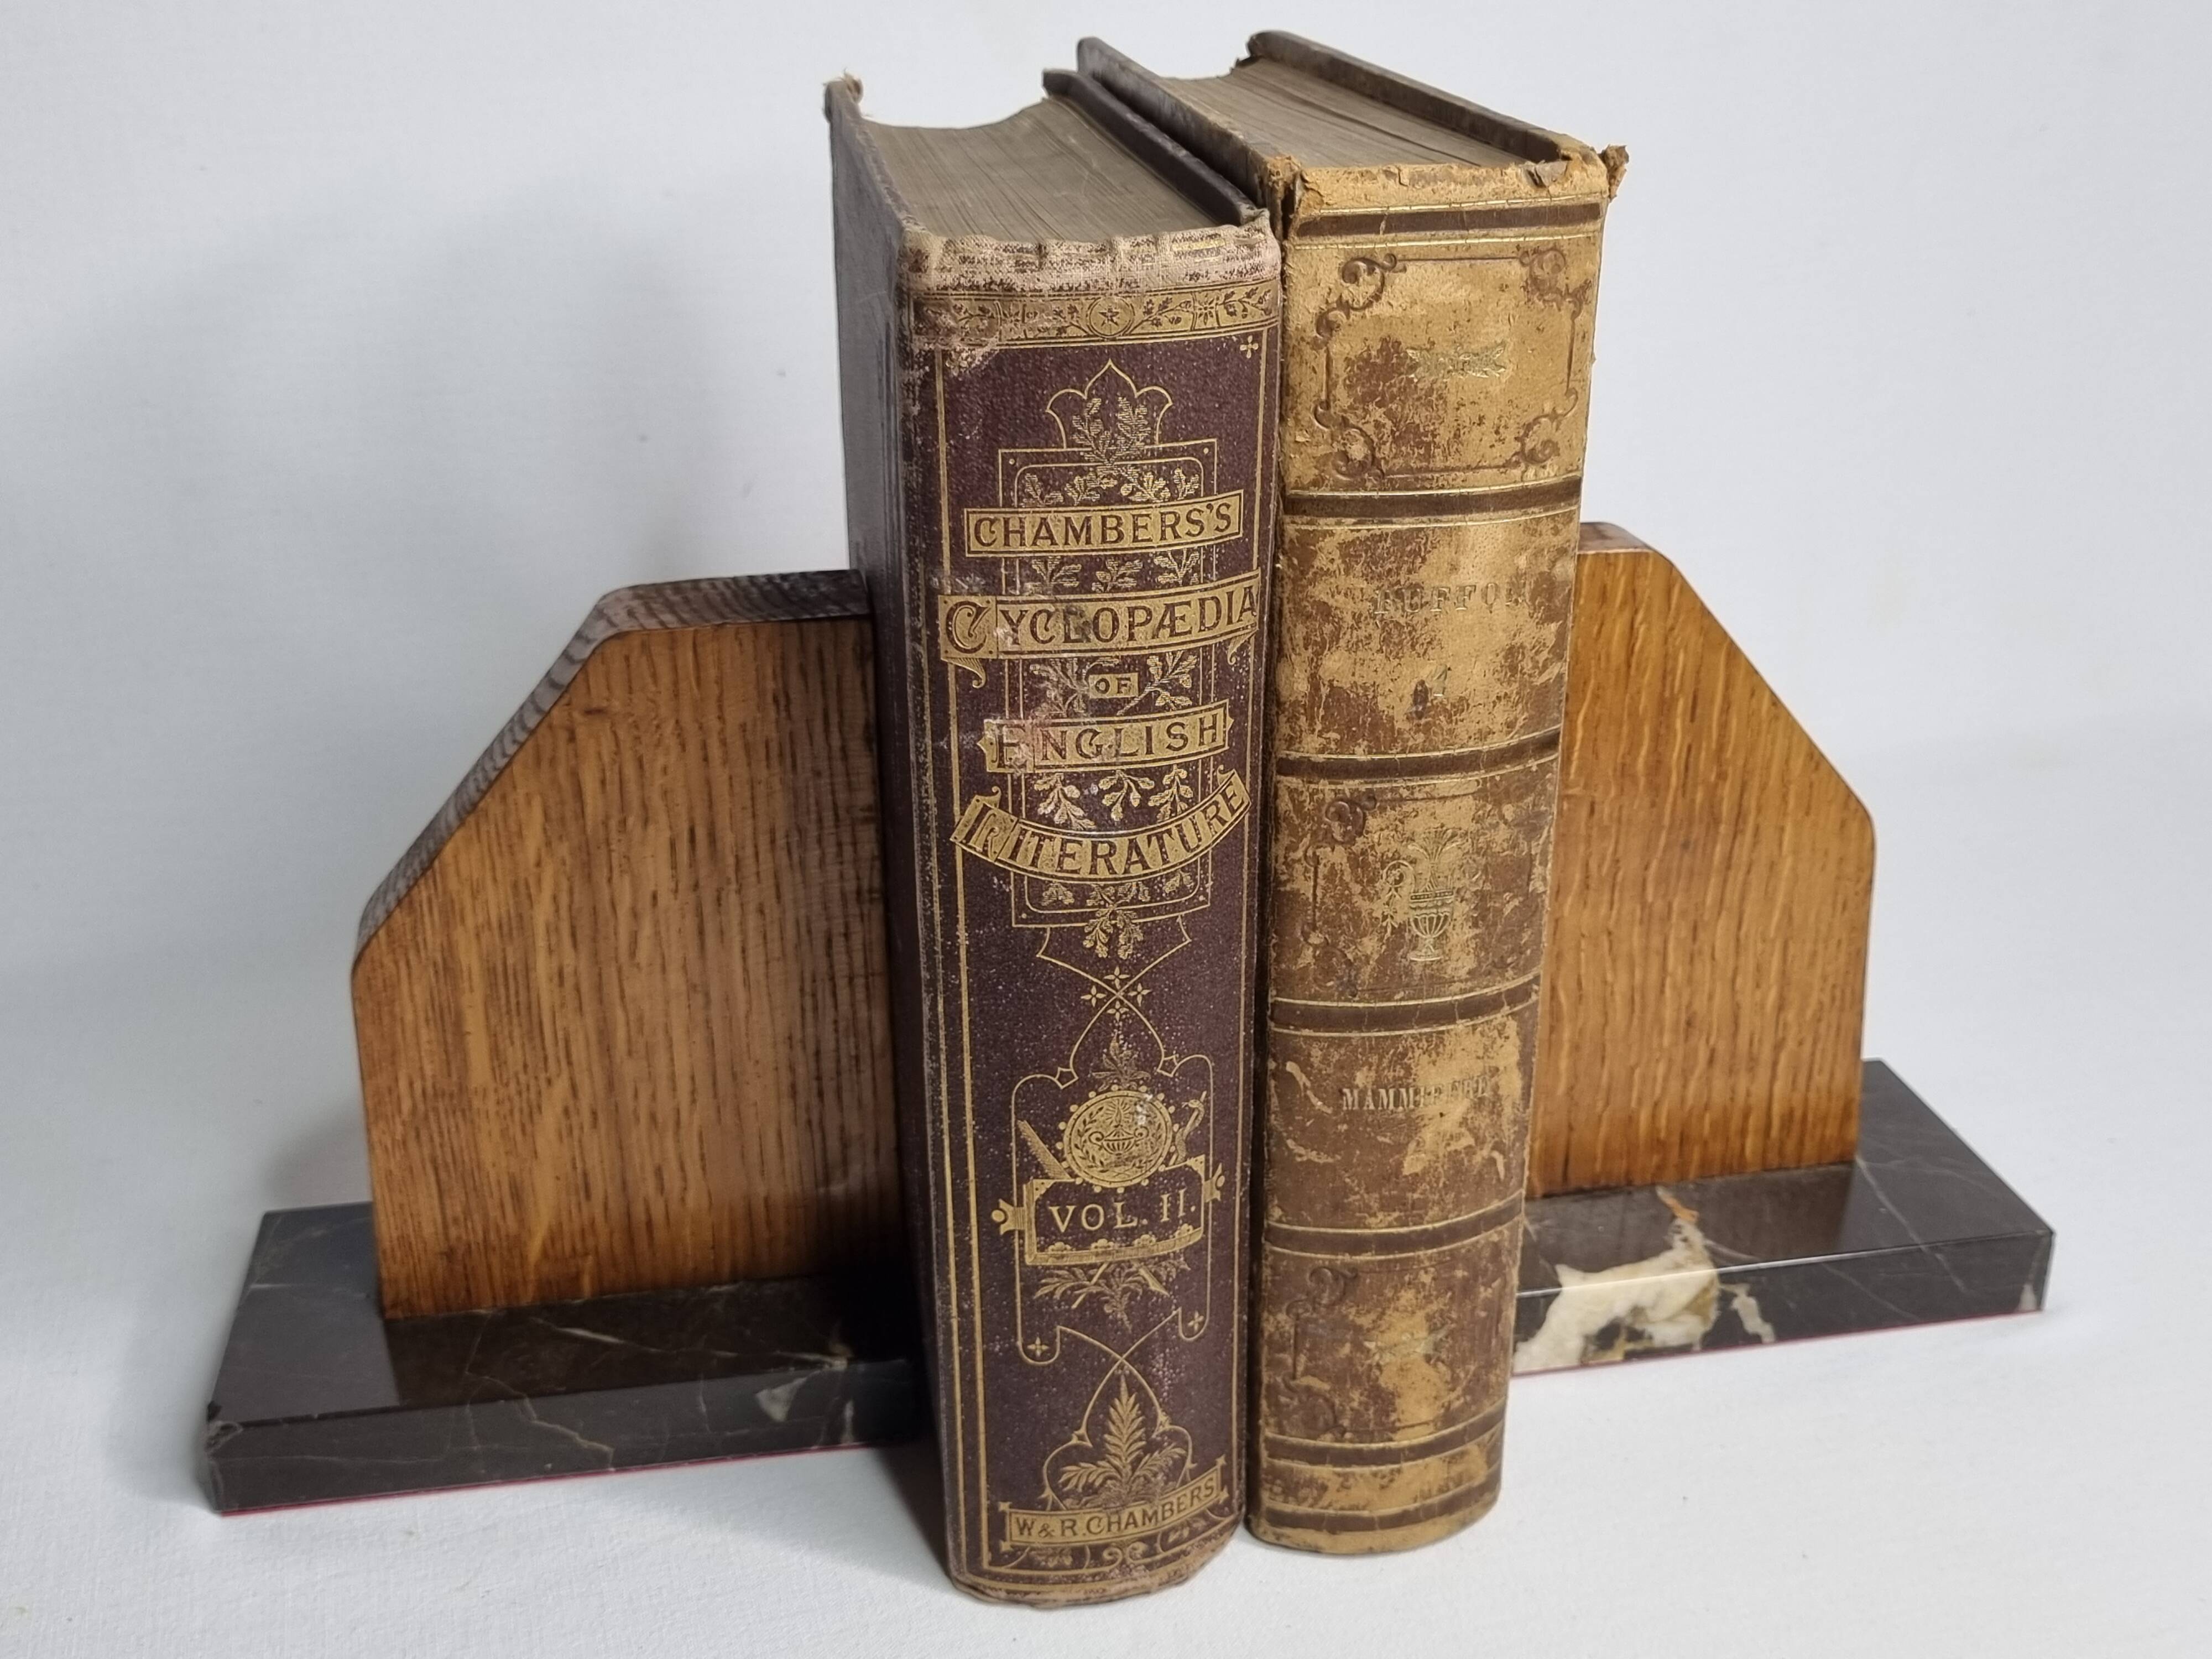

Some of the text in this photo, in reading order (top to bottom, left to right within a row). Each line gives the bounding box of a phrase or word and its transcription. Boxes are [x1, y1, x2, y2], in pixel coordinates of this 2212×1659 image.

[973, 502, 1232, 547] CHAMBERS'S
[946, 587, 1258, 654] CYCLOPÆDIA
[1094, 677, 1131, 694] OF
[997, 713, 1218, 766] ENGLISH
[959, 786, 1245, 875] LITERATURE
[1049, 1201, 1147, 1233] VOL.
[1016, 1517, 1034, 1536] W
[1037, 1523, 1054, 1538] &
[1086, 1477, 1215, 1536] CHAMBERS
